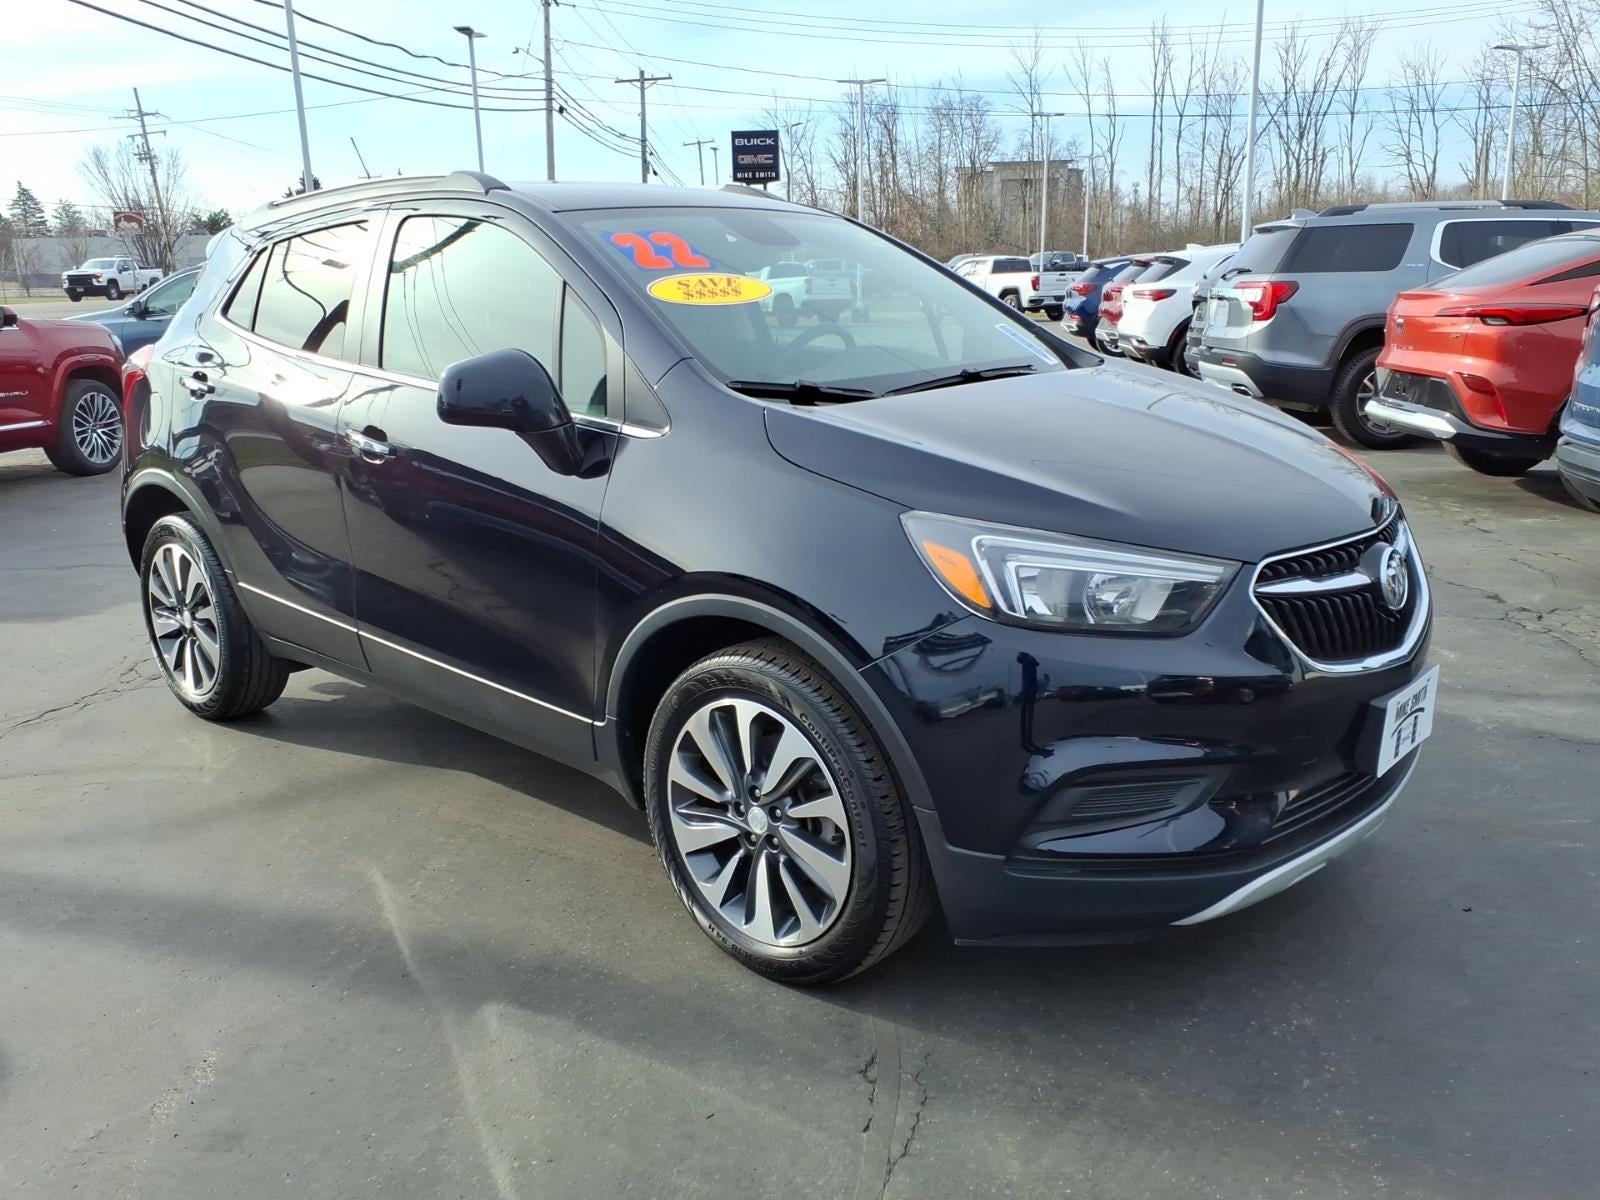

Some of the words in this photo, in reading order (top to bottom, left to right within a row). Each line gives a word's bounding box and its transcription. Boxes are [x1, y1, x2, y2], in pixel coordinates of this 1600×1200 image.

[735, 137, 775, 146] BUICK
[737, 154, 774, 164] GMC
[611, 232, 709, 268] 22
[676, 277, 740, 290] SAVE
[1410, 685, 1428, 711] SMITH
